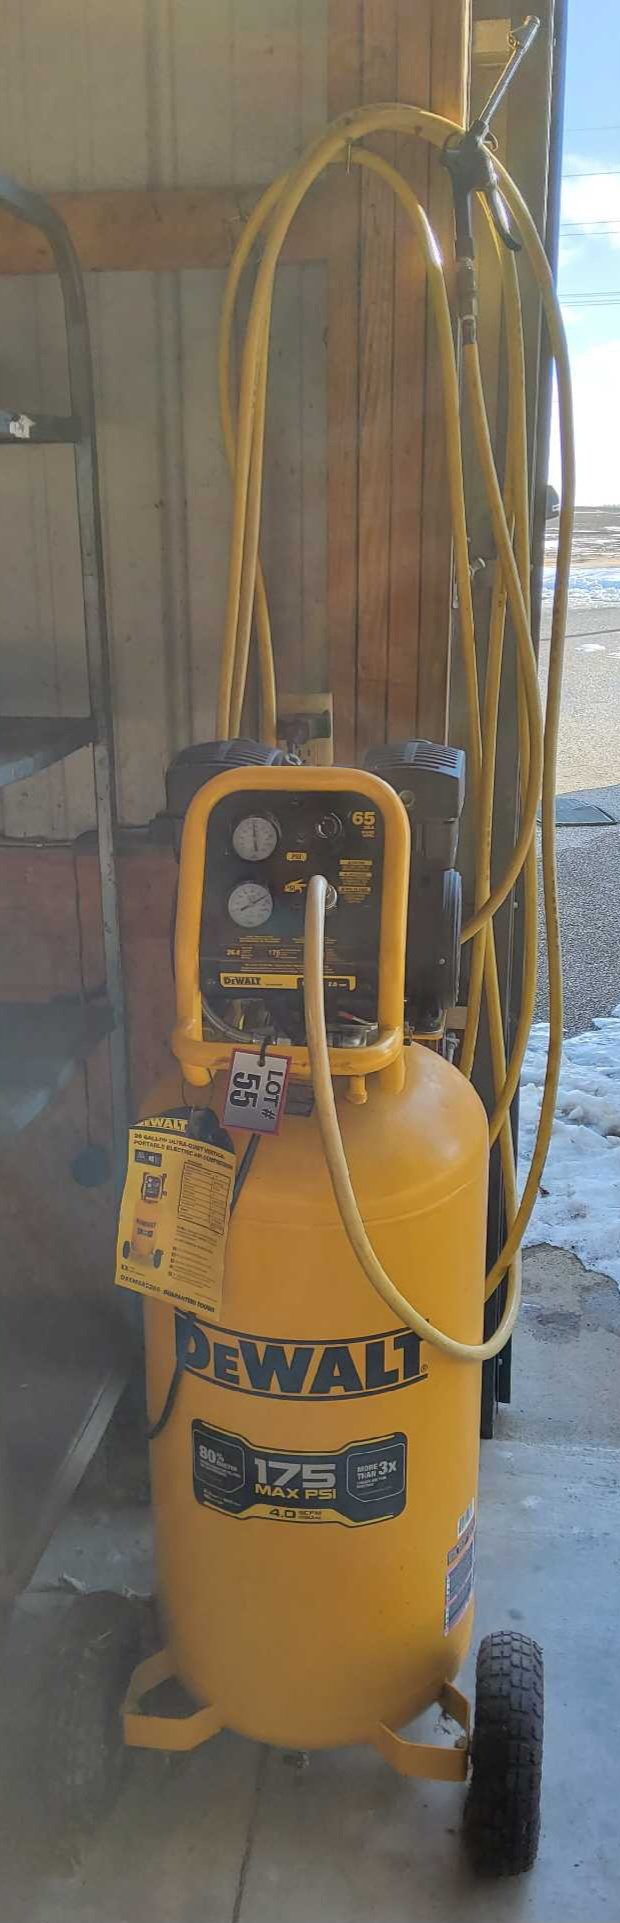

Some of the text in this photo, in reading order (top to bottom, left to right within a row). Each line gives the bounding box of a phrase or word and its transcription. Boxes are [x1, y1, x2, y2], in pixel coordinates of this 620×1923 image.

[352, 811, 376, 825] 65
[224, 976, 261, 985] DEWALT
[229, 1071, 262, 1108] 55
[264, 1070, 283, 1107] LOT
[174, 1312, 424, 1394] DEWALT
[254, 1456, 336, 1488] 175
[357, 1463, 378, 1473] MORE
[357, 1471, 377, 1481] THAN
[254, 1483, 300, 1499] MAX
[305, 1488, 337, 1500] PSI
[268, 1508, 296, 1519] 4.0
